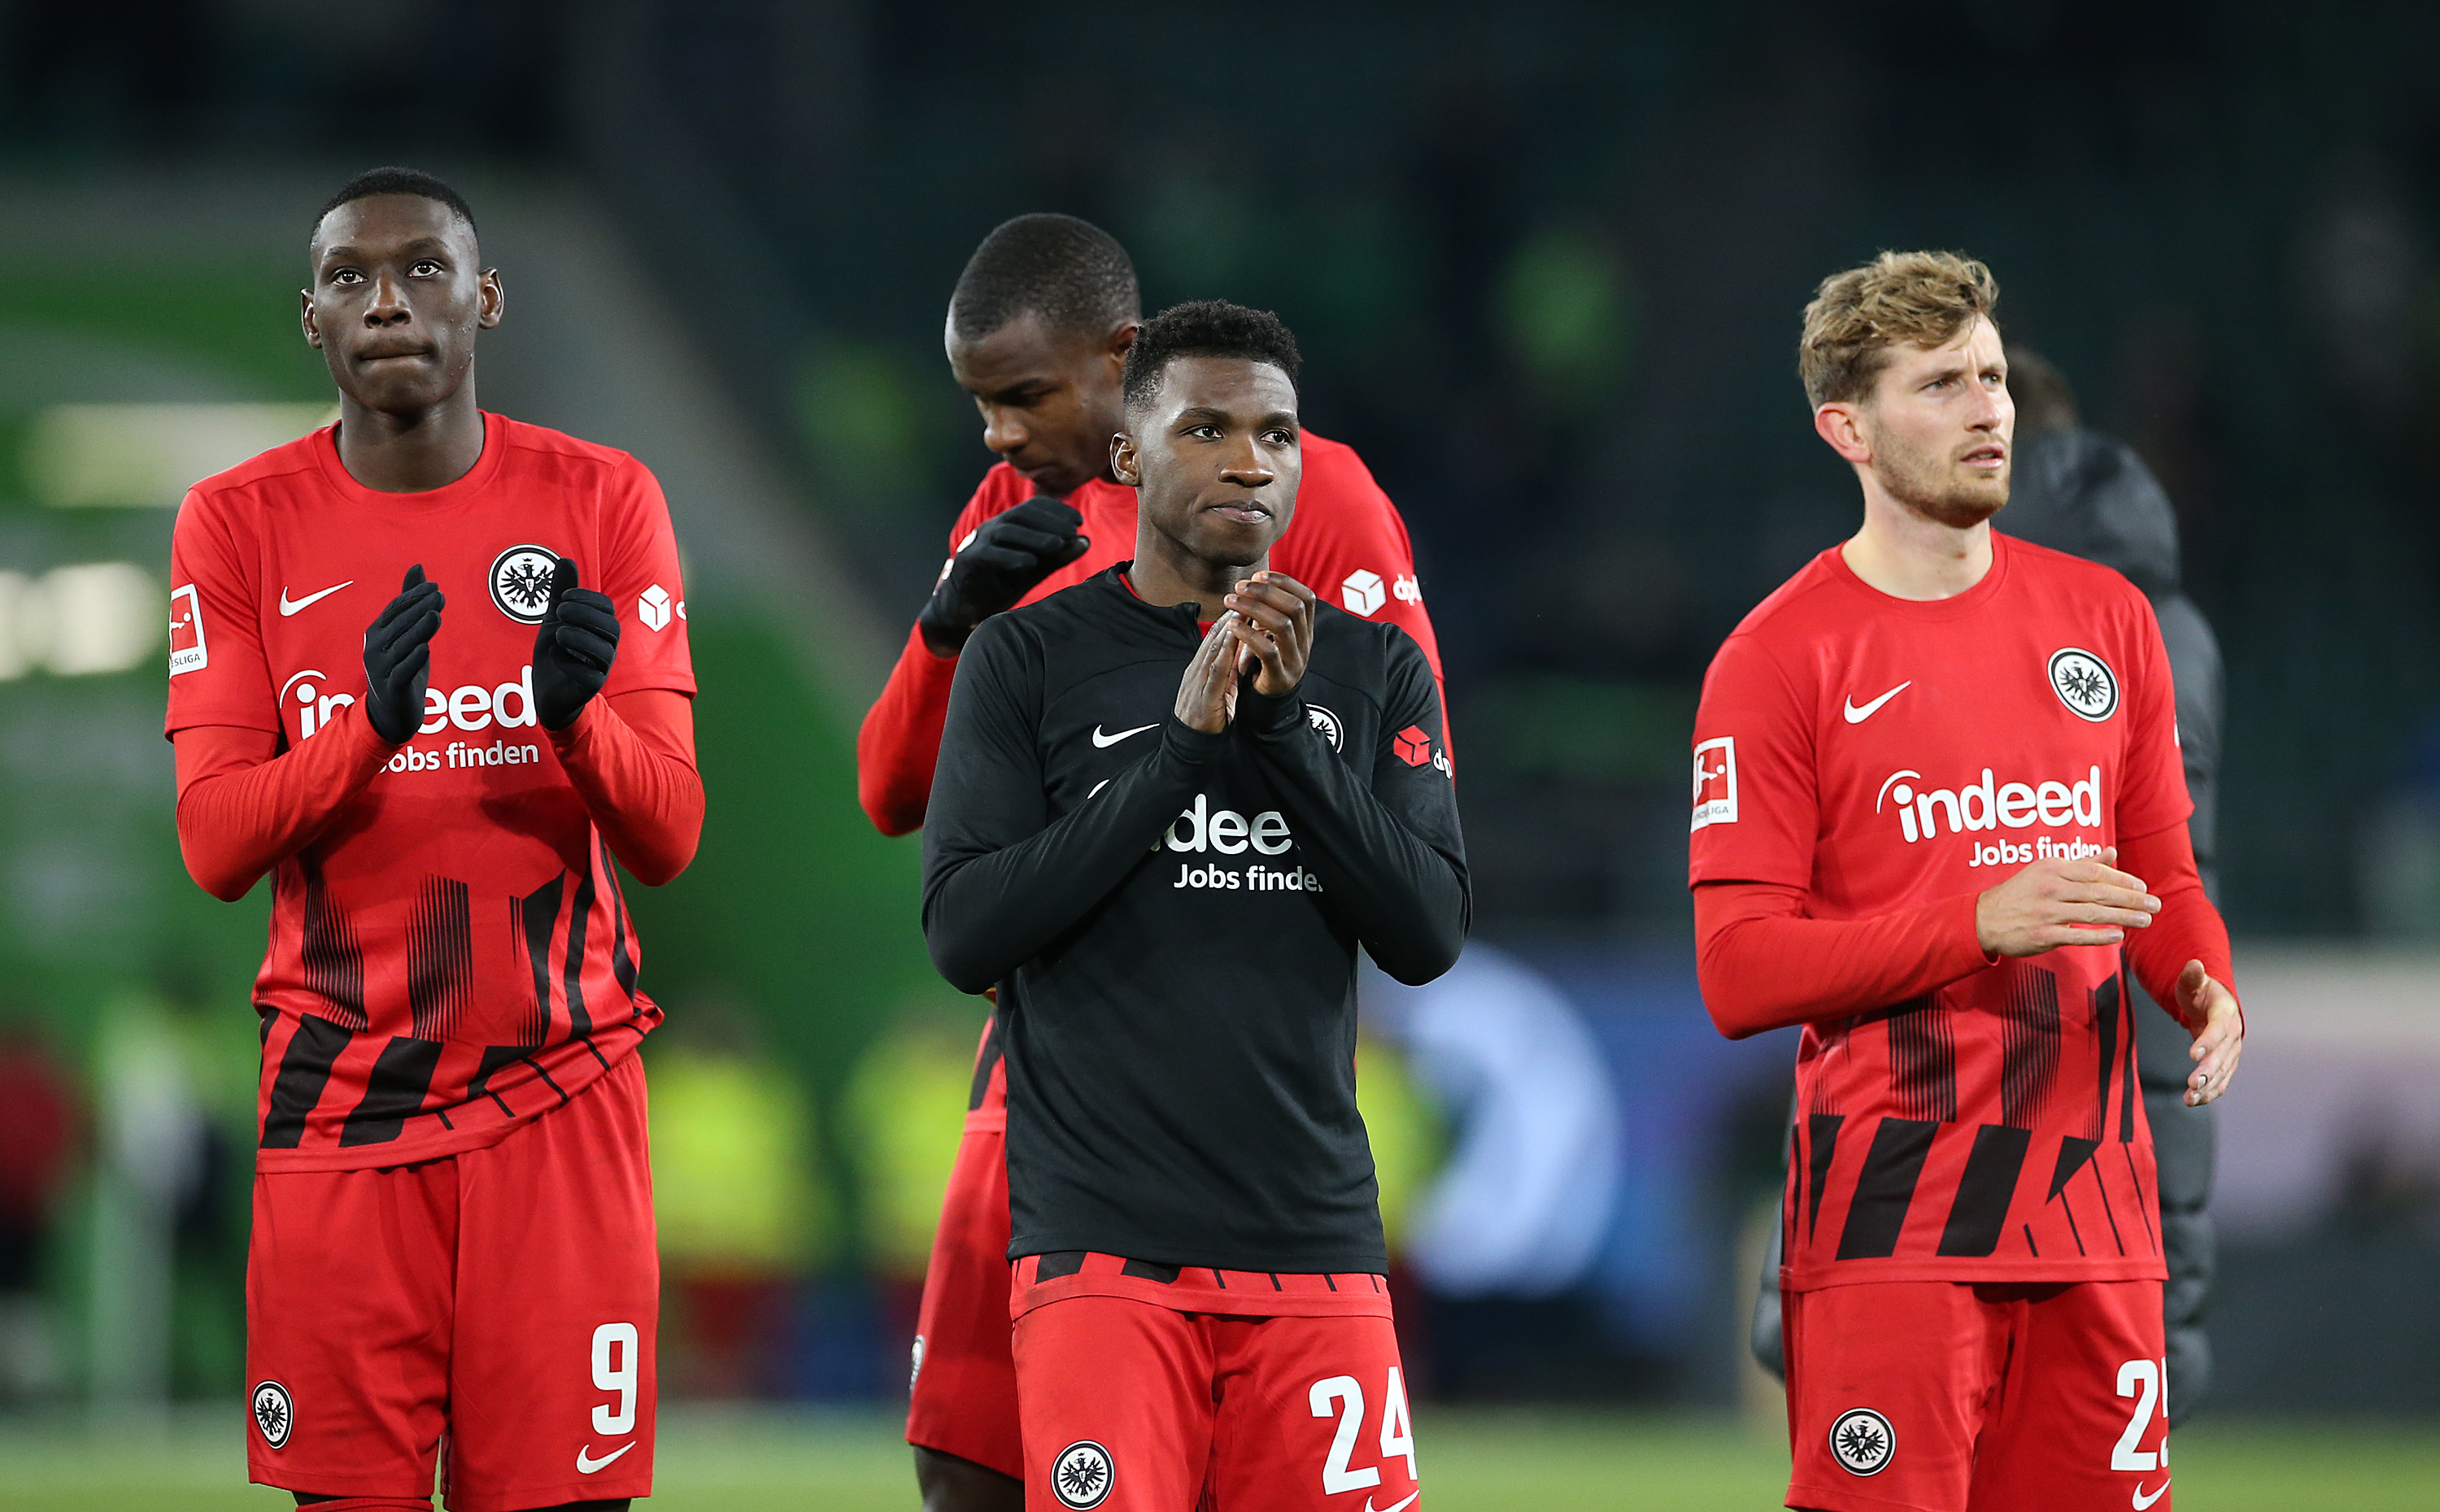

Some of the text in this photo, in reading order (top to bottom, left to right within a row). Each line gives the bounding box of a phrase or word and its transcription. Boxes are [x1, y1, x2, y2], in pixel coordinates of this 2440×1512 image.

[279, 664, 538, 740] ineed
[380, 739, 538, 773] obs finden
[1150, 793, 1302, 855] dee
[1876, 765, 2102, 843] indeed
[1174, 862, 1324, 892] Jobs finde
[1968, 839, 2034, 868] Jobs
[590, 1322, 639, 1436] 9
[1308, 1366, 1419, 1497] 24
